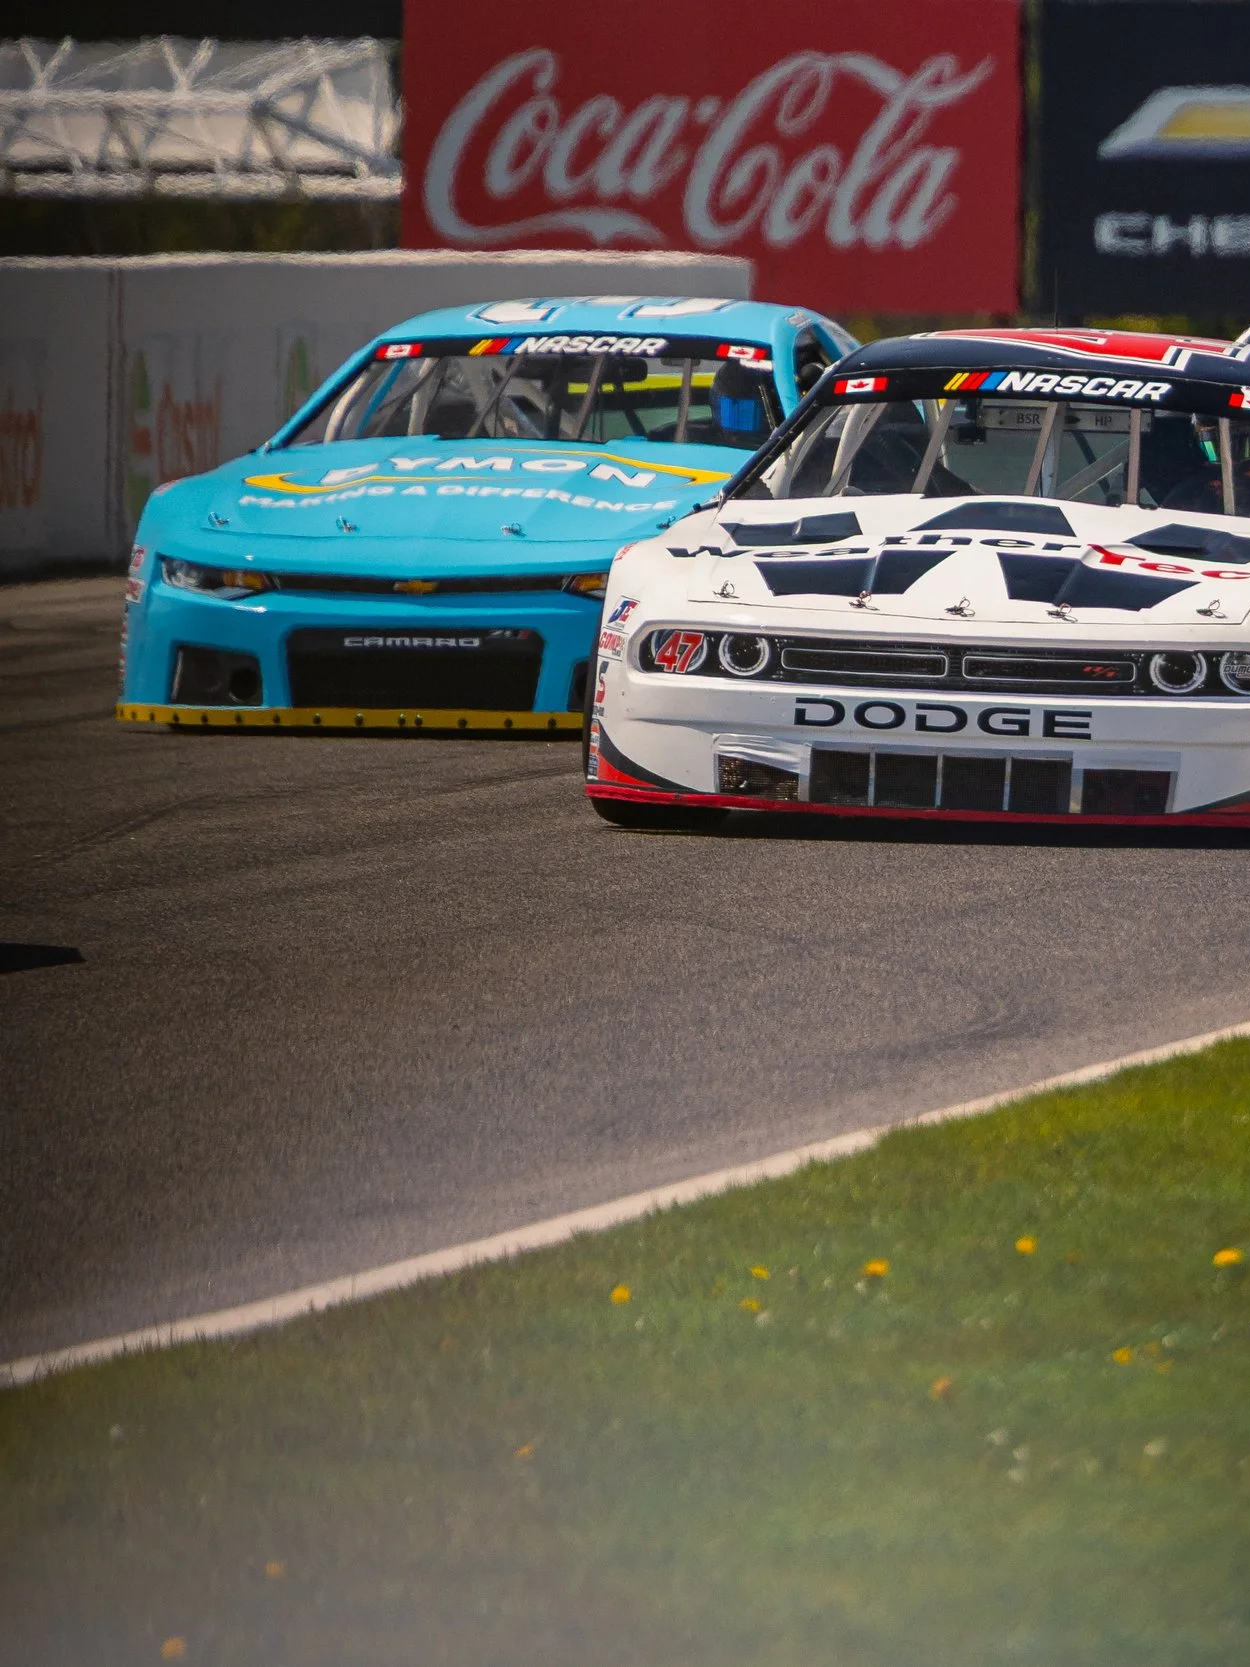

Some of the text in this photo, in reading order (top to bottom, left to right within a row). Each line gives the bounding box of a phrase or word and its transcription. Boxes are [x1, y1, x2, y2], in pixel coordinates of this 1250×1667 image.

[513, 335, 669, 355] NASCAR
[997, 371, 1172, 400] NASCAR
[1016, 412, 1041, 425] BSR
[1095, 415, 1112, 427] HP
[401, 485, 427, 496] A
[436, 485, 678, 512] DIFFERENCE
[344, 636, 480, 648] CAMARO
[655, 630, 705, 673] 47
[794, 696, 1092, 740] DODGE
